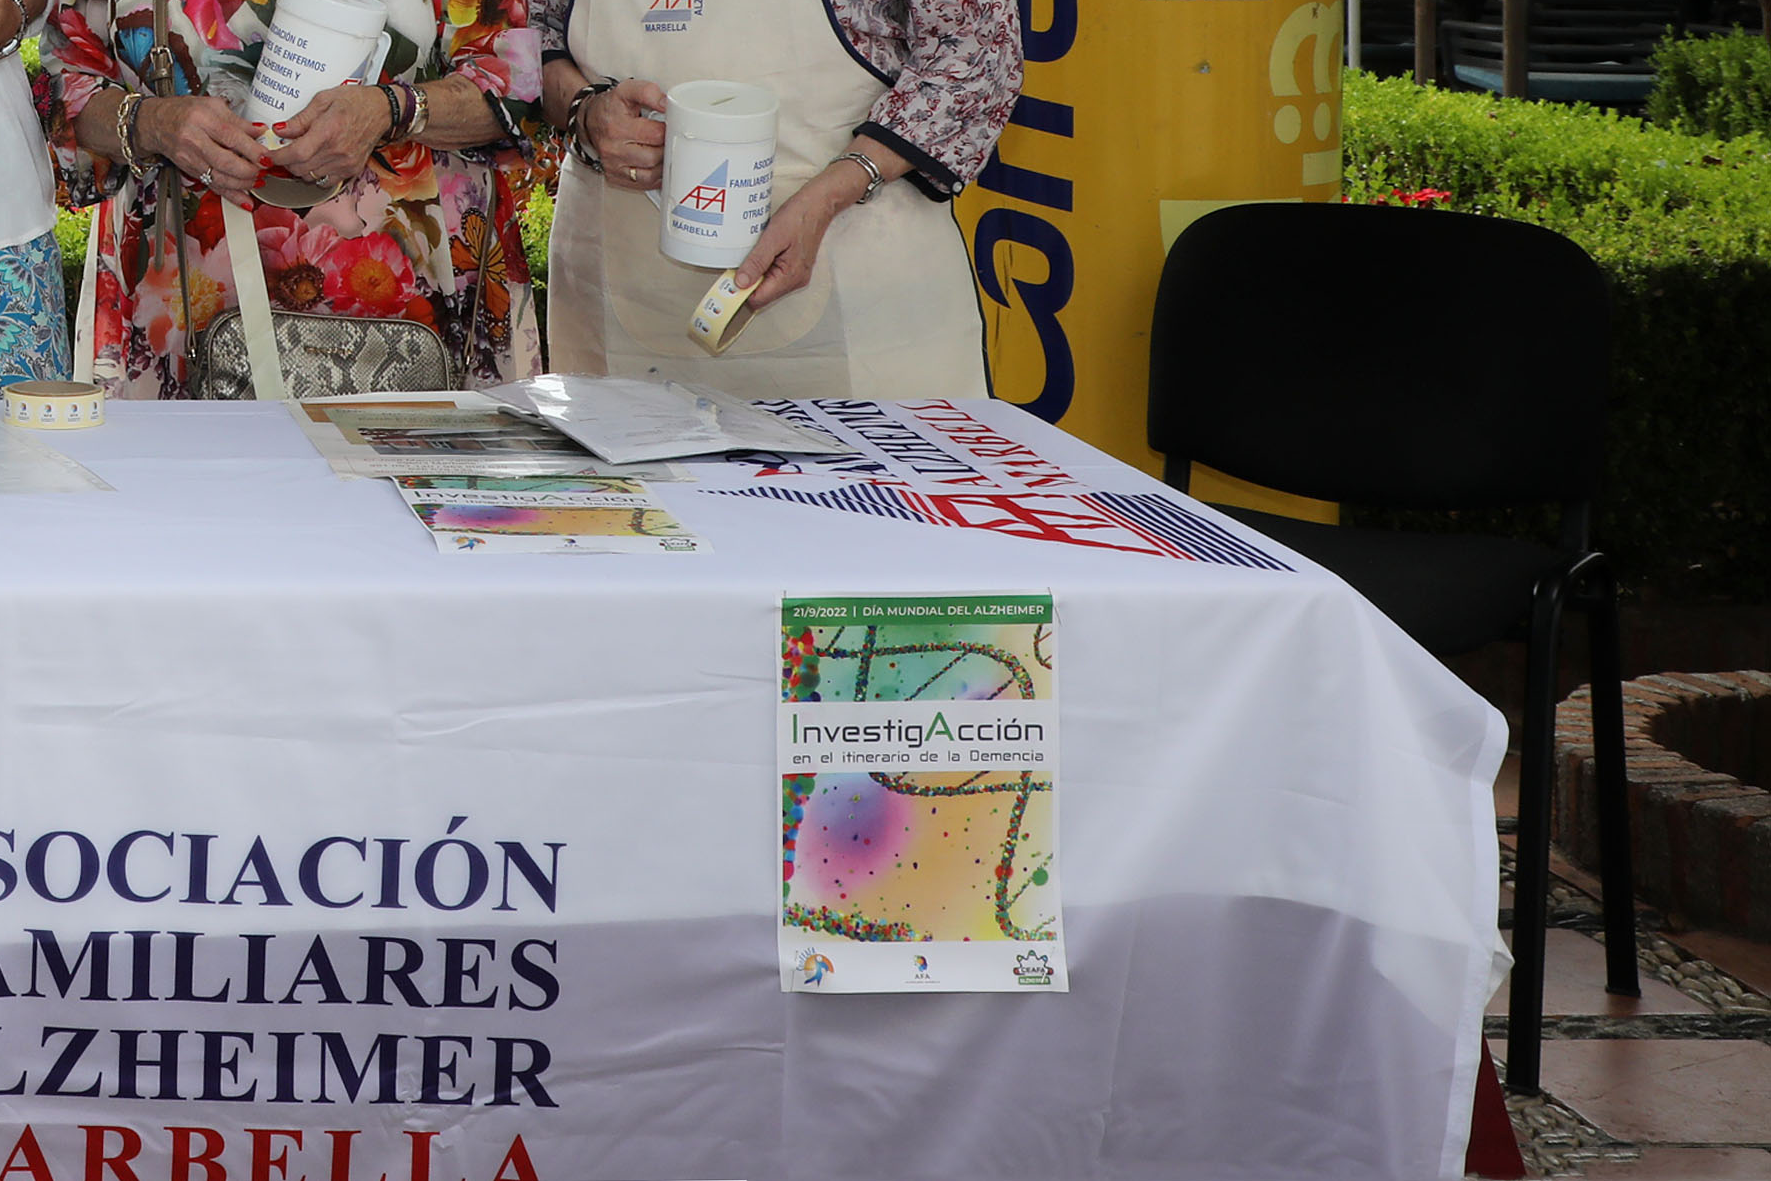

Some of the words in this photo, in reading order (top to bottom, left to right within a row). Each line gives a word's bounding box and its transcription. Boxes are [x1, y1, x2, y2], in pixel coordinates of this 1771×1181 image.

[645, 23, 688, 33] MARBELLA
[261, 56, 292, 80] LZHEIMER
[283, 50, 326, 72] ENFERMOS
[261, 74, 301, 99] DEMENCIAS
[254, 88, 286, 112] MARBELLA
[679, 185, 727, 213] AFA
[742, 207, 764, 220] OTRAS
[672, 219, 718, 238] MARBELLA
[413, 490, 648, 504] InvestigAcción
[793, 606, 848, 618] 21/9/2022
[862, 604, 884, 617] DÍA
[887, 605, 945, 617] MUNDIAL
[947, 605, 972, 616] DEL
[973, 604, 1045, 616] ALZHEIMER
[792, 712, 1044, 748] InvestigAcción
[792, 753, 812, 764] en
[820, 751, 833, 764] el
[842, 751, 910, 763] itinerario
[919, 750, 939, 763] de
[948, 750, 961, 762] la
[970, 749, 1044, 762] Demencia
